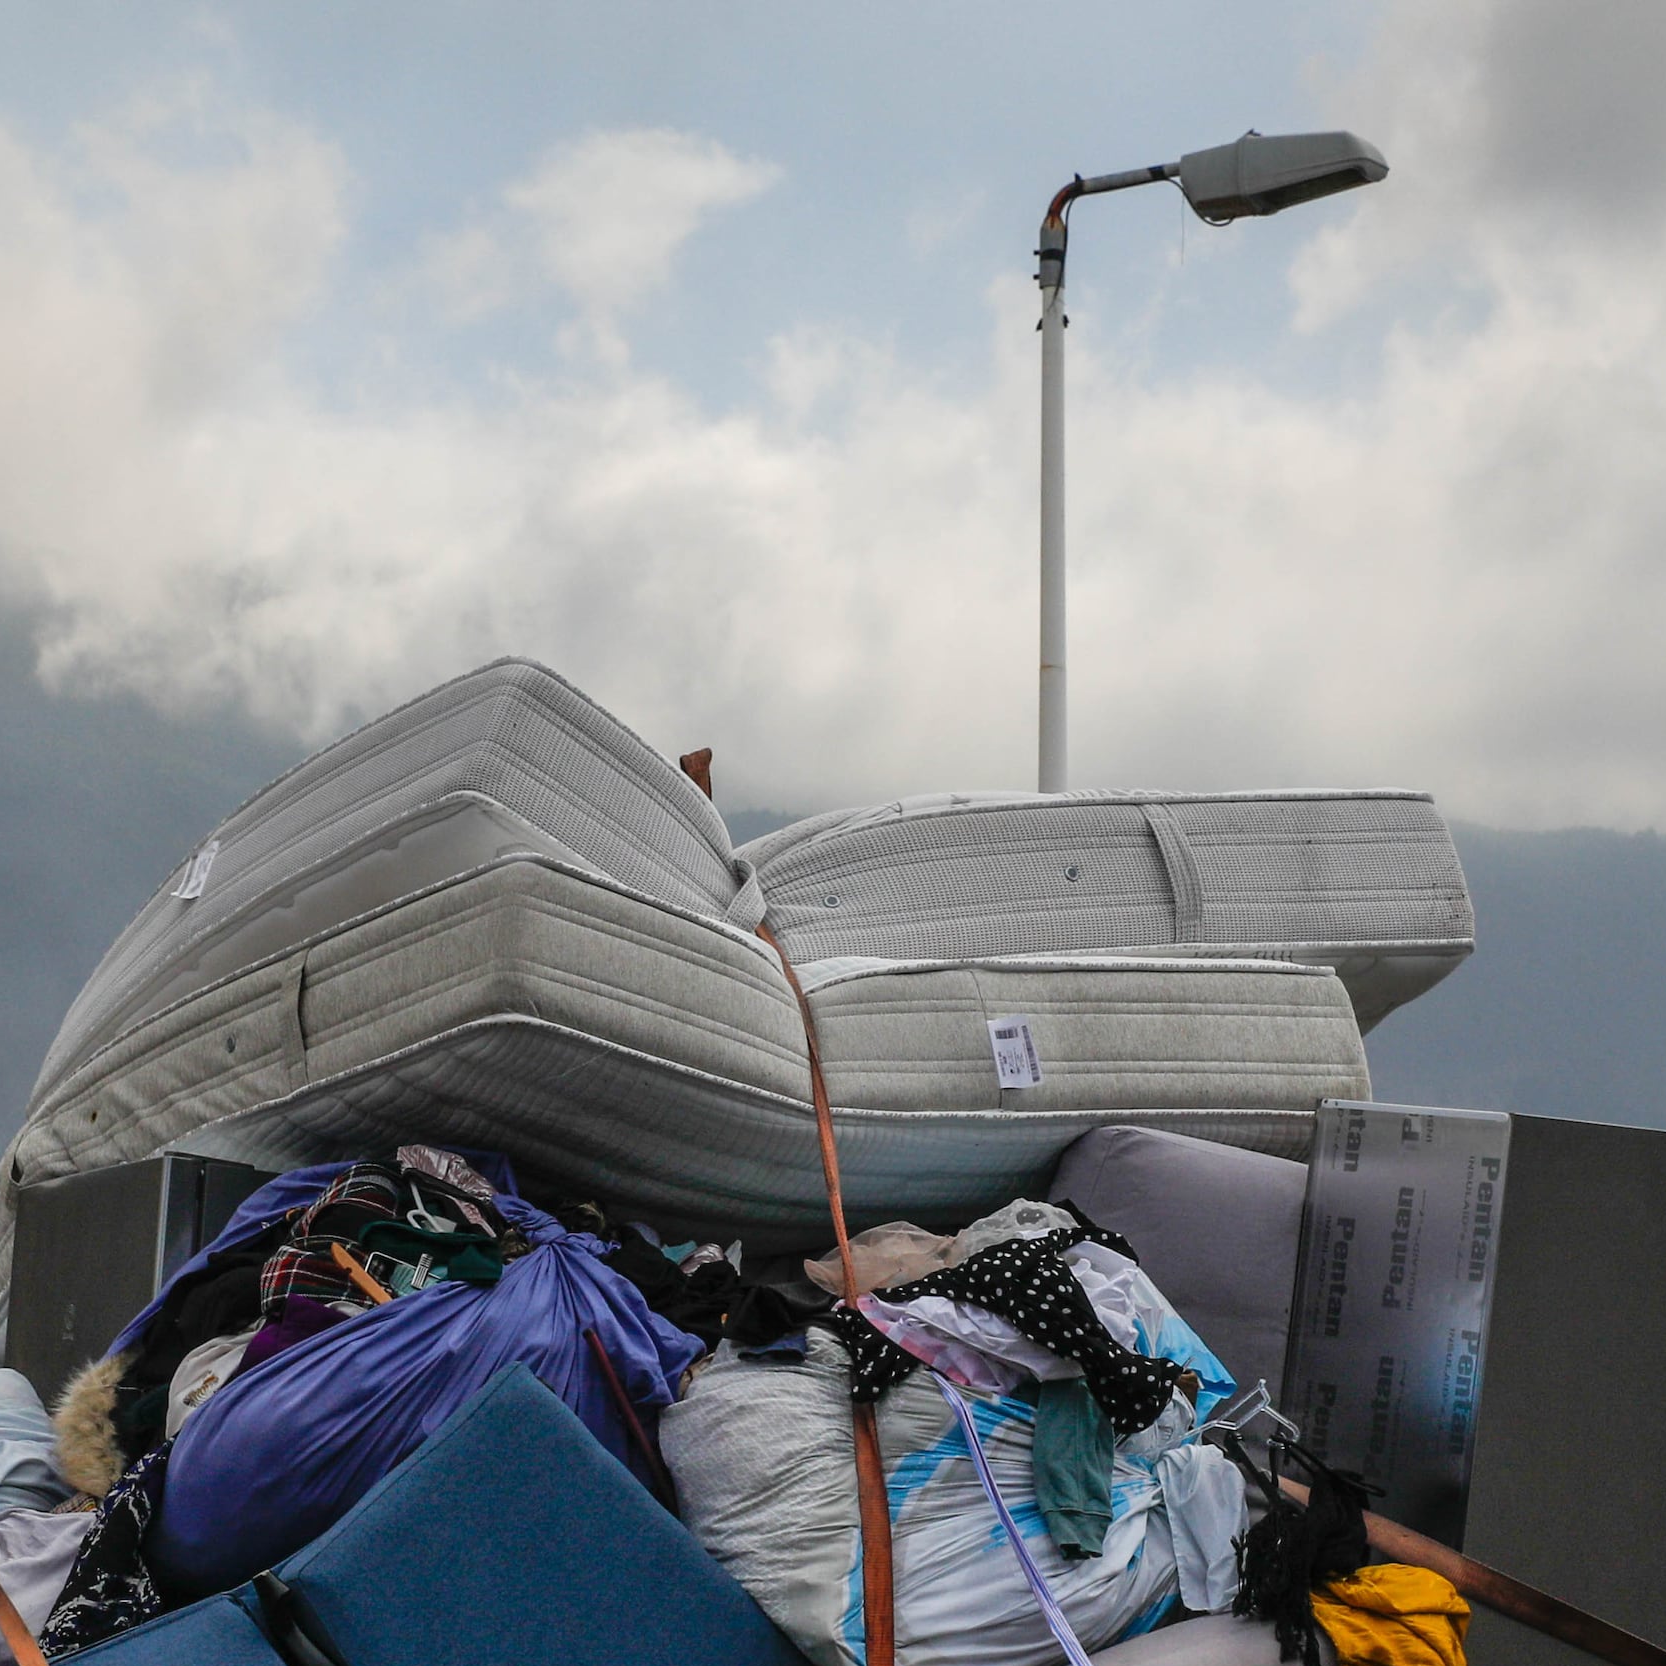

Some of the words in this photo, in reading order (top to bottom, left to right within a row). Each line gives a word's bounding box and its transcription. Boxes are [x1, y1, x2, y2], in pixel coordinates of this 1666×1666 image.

[1324, 1216, 1357, 1337] Pentan
[1380, 1186, 1416, 1309] Pentan
[1468, 1156, 1502, 1282] Pentan
[1447, 1330, 1481, 1455] Pentan
